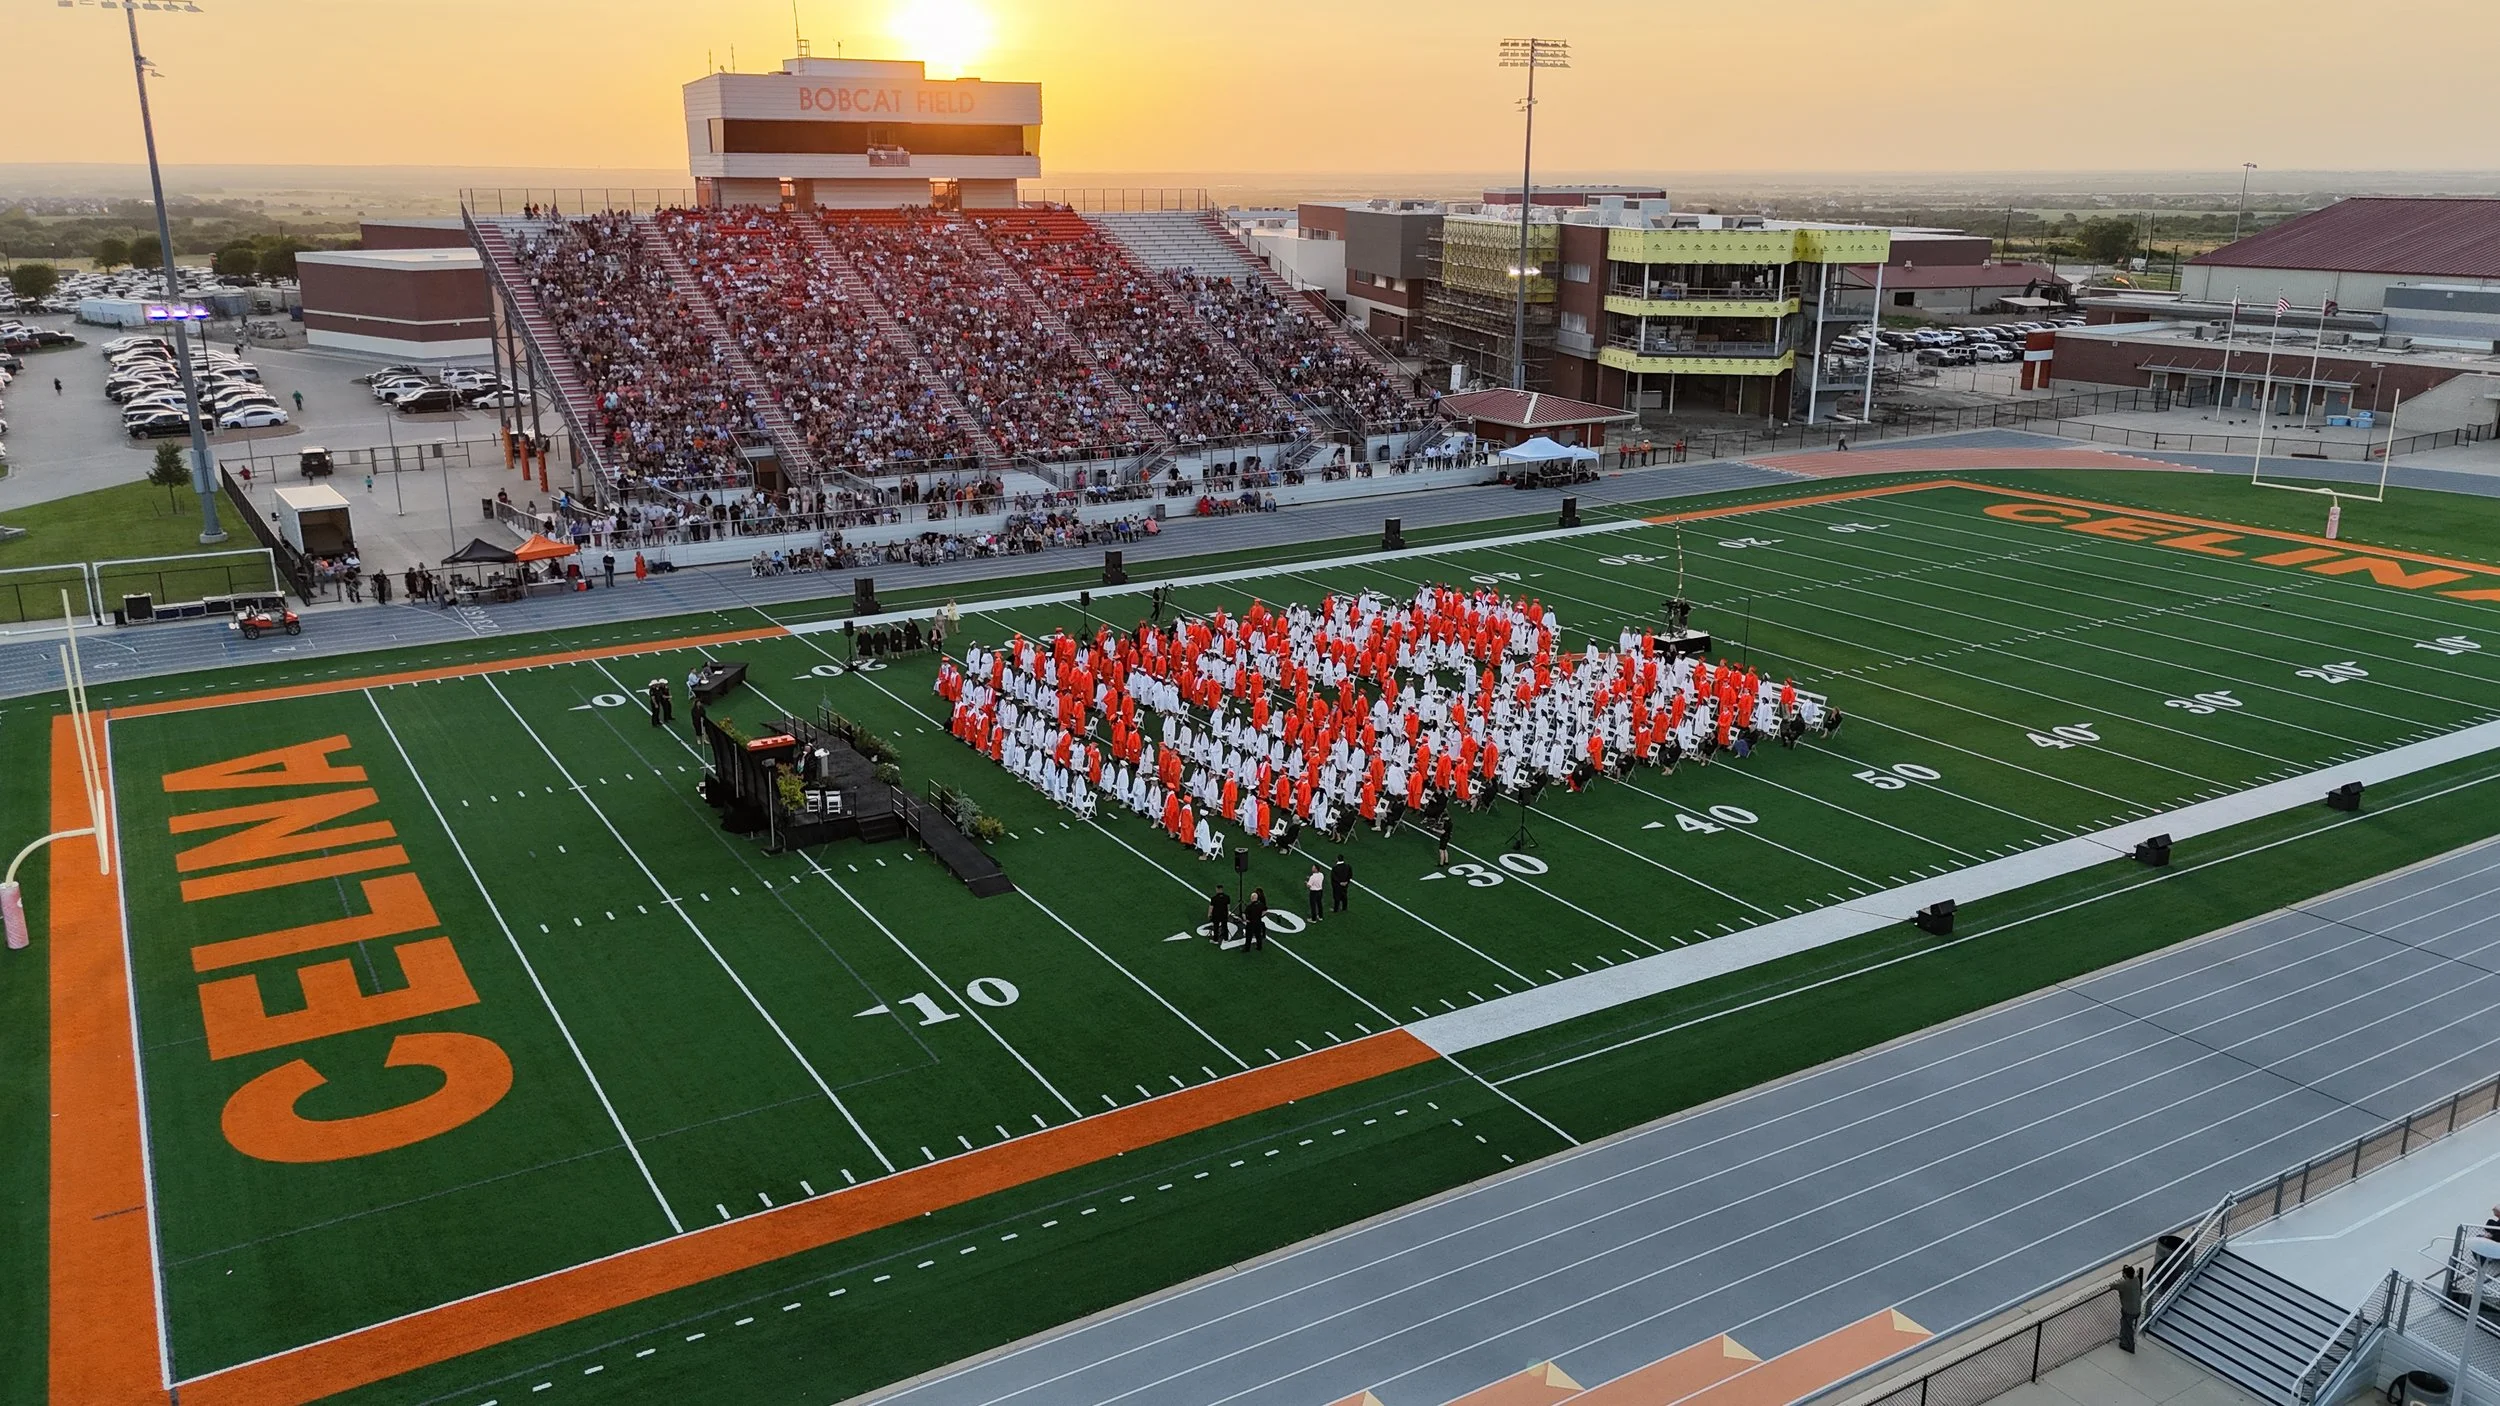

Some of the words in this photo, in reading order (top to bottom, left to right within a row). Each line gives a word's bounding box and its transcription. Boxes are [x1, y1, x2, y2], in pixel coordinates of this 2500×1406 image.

[799, 86, 902, 113] BOBCAT
[916, 90, 974, 114] FIELD
[2412, 635, 2482, 656] 10
[2295, 661, 2370, 684] 20
[2164, 691, 2243, 714] 30
[2026, 725, 2101, 750] 40
[1852, 762, 1942, 790] 50
[1674, 805, 1759, 835] 40
[1448, 852, 1549, 888] 30
[162, 734, 513, 1163] CELINA
[898, 976, 1020, 1027] 10
